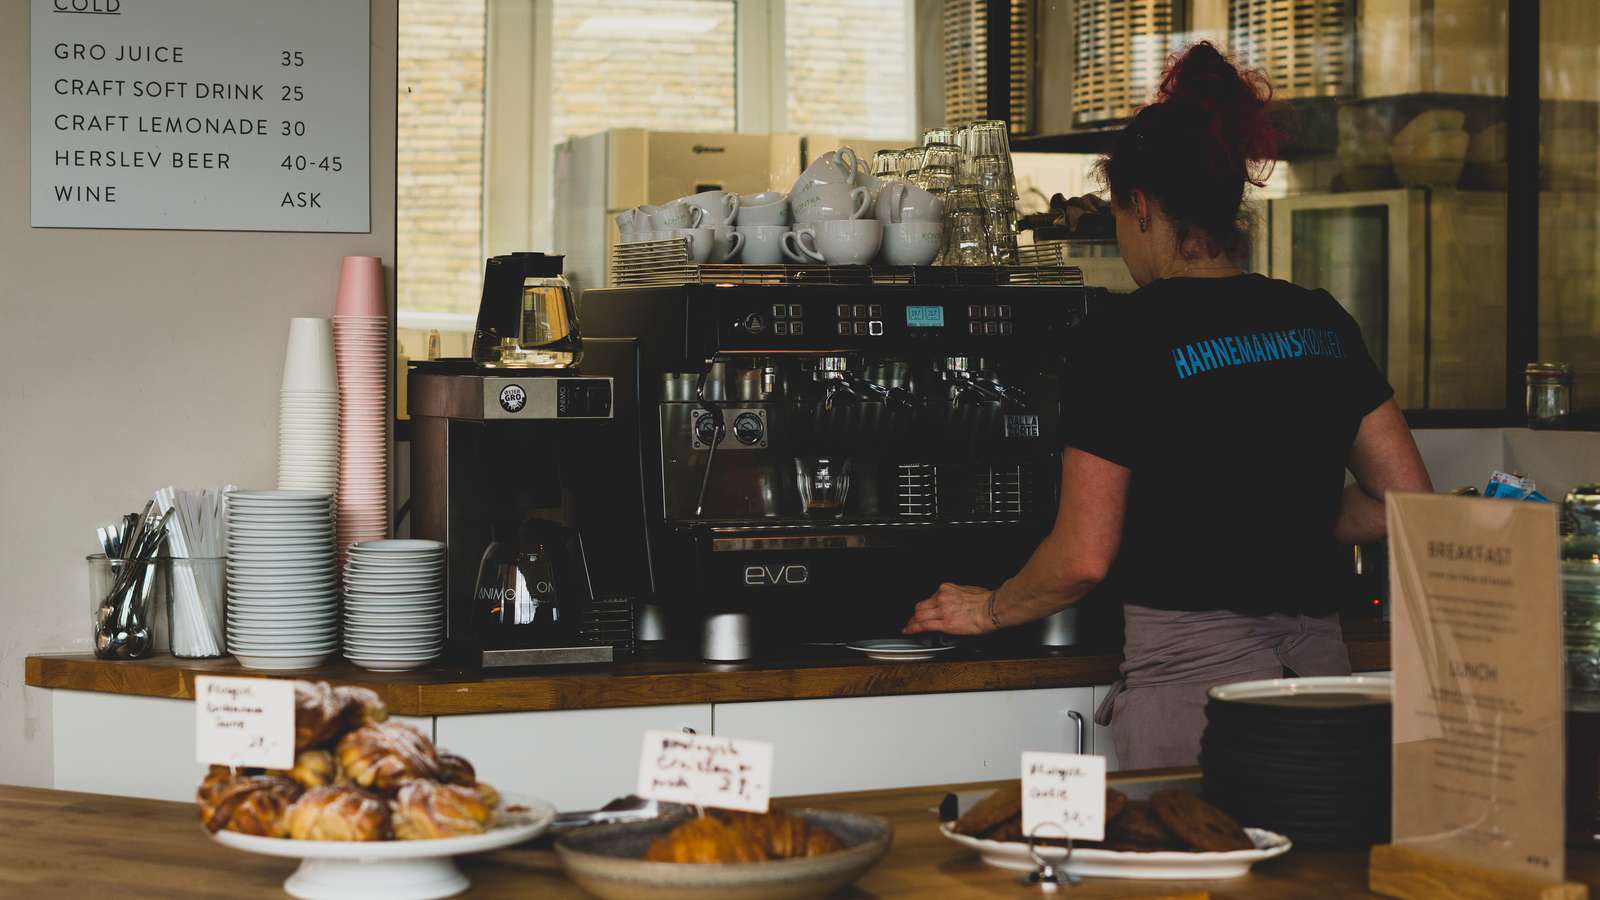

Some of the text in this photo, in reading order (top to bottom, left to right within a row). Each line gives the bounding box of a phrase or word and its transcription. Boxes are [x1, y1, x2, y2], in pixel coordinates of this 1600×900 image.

[53, 0, 121, 13] COLD
[54, 42, 305, 67] GRO JUICE 35
[54, 78, 304, 102] CRAFT SOFT DRINK 25
[54, 113, 306, 137] CRAFT LEMONADE 30
[54, 149, 343, 172] HERSLEV BEER 40-45
[54, 185, 322, 209] WINE ASK
[504, 393, 522, 402] GRO
[1427, 541, 1513, 565] BREAKFAST
[479, 587, 516, 600] ANIMO
[1450, 662, 1498, 681] LUNCH
